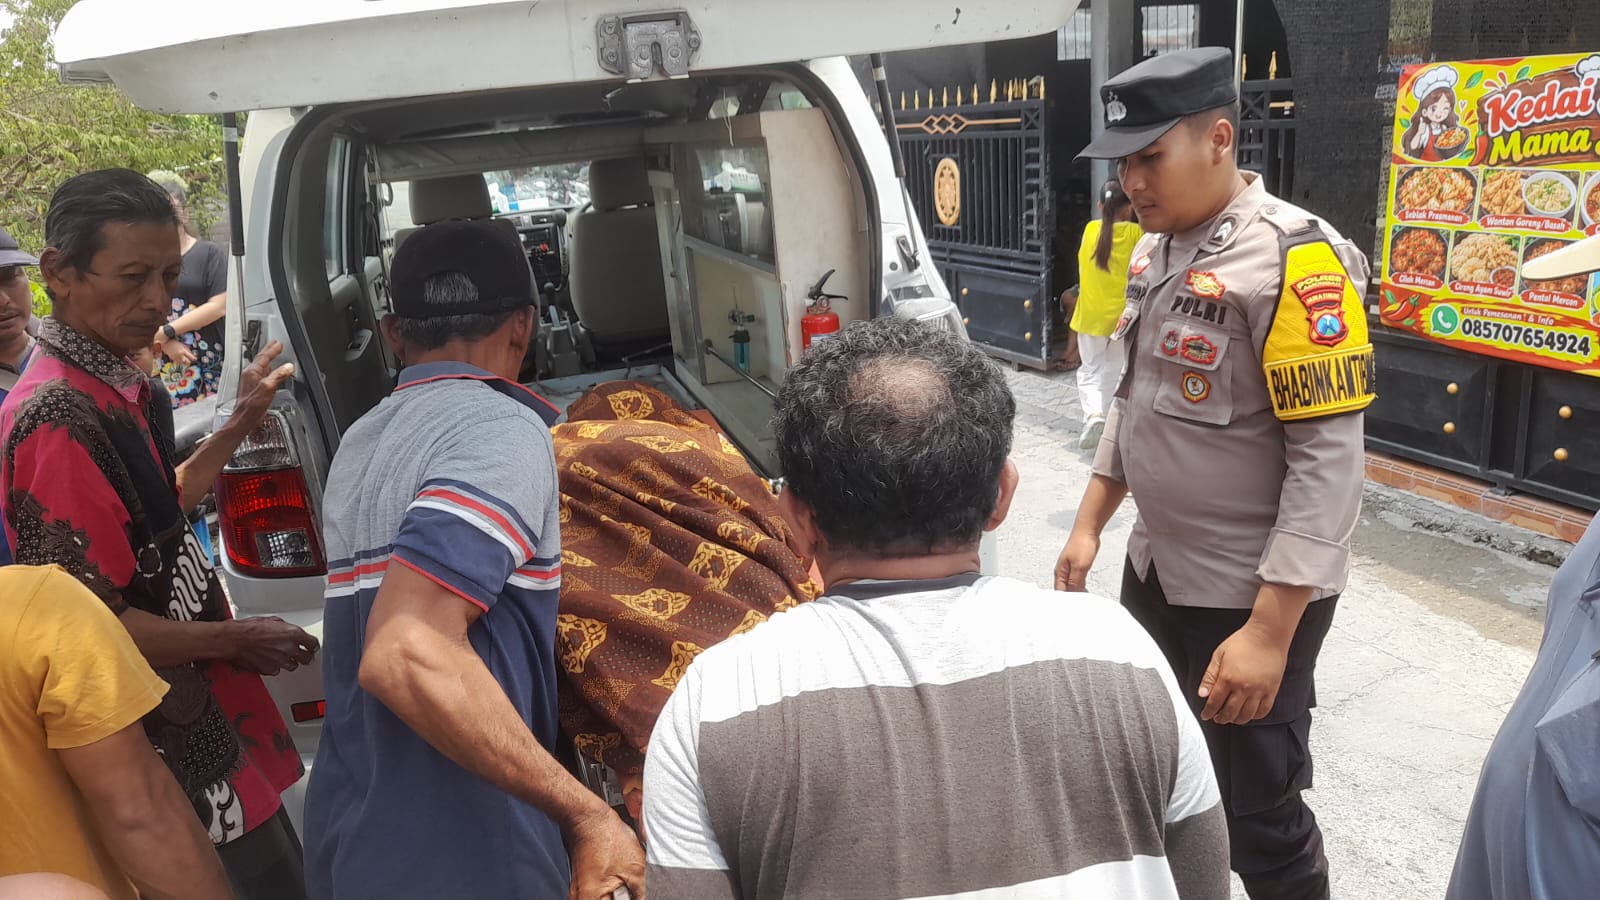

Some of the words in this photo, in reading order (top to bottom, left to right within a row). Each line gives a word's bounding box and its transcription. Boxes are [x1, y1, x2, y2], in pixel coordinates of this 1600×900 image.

[1485, 77, 1595, 136] Kedai
[1488, 129, 1592, 166] Mama
[1428, 212, 1463, 223] Prasmanan
[1487, 216, 1514, 226] Wonton
[1170, 295, 1227, 325] POLRI
[1528, 292, 1552, 303] Pentol
[1552, 295, 1578, 307] Mercon
[1463, 307, 1481, 316] Untuk
[1482, 308, 1522, 321] Pemesanan
[1527, 314, 1535, 323] &
[1537, 315, 1555, 326] Info
[1461, 318, 1591, 357] 085707654924
